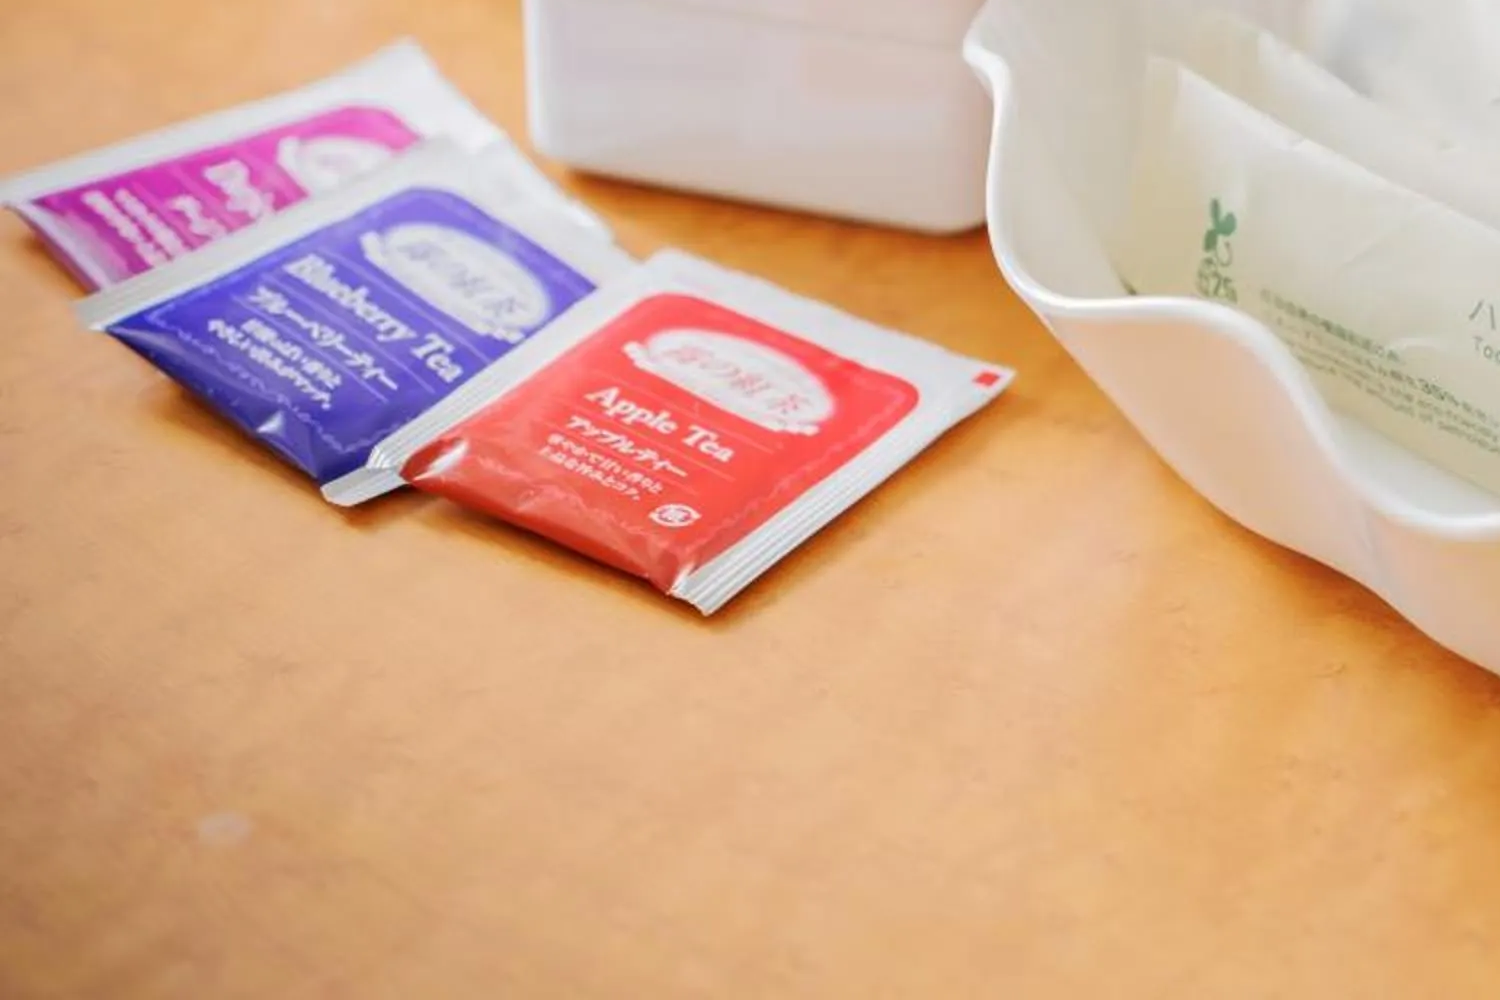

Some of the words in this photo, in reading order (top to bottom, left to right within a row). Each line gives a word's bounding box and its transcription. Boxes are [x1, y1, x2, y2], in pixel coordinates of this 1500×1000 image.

[283, 252, 418, 342] Blueberry
[411, 330, 464, 384] Tea
[566, 414, 689, 478] アップルティー
[585, 385, 679, 436] Apple
[682, 424, 736, 464] Tea
